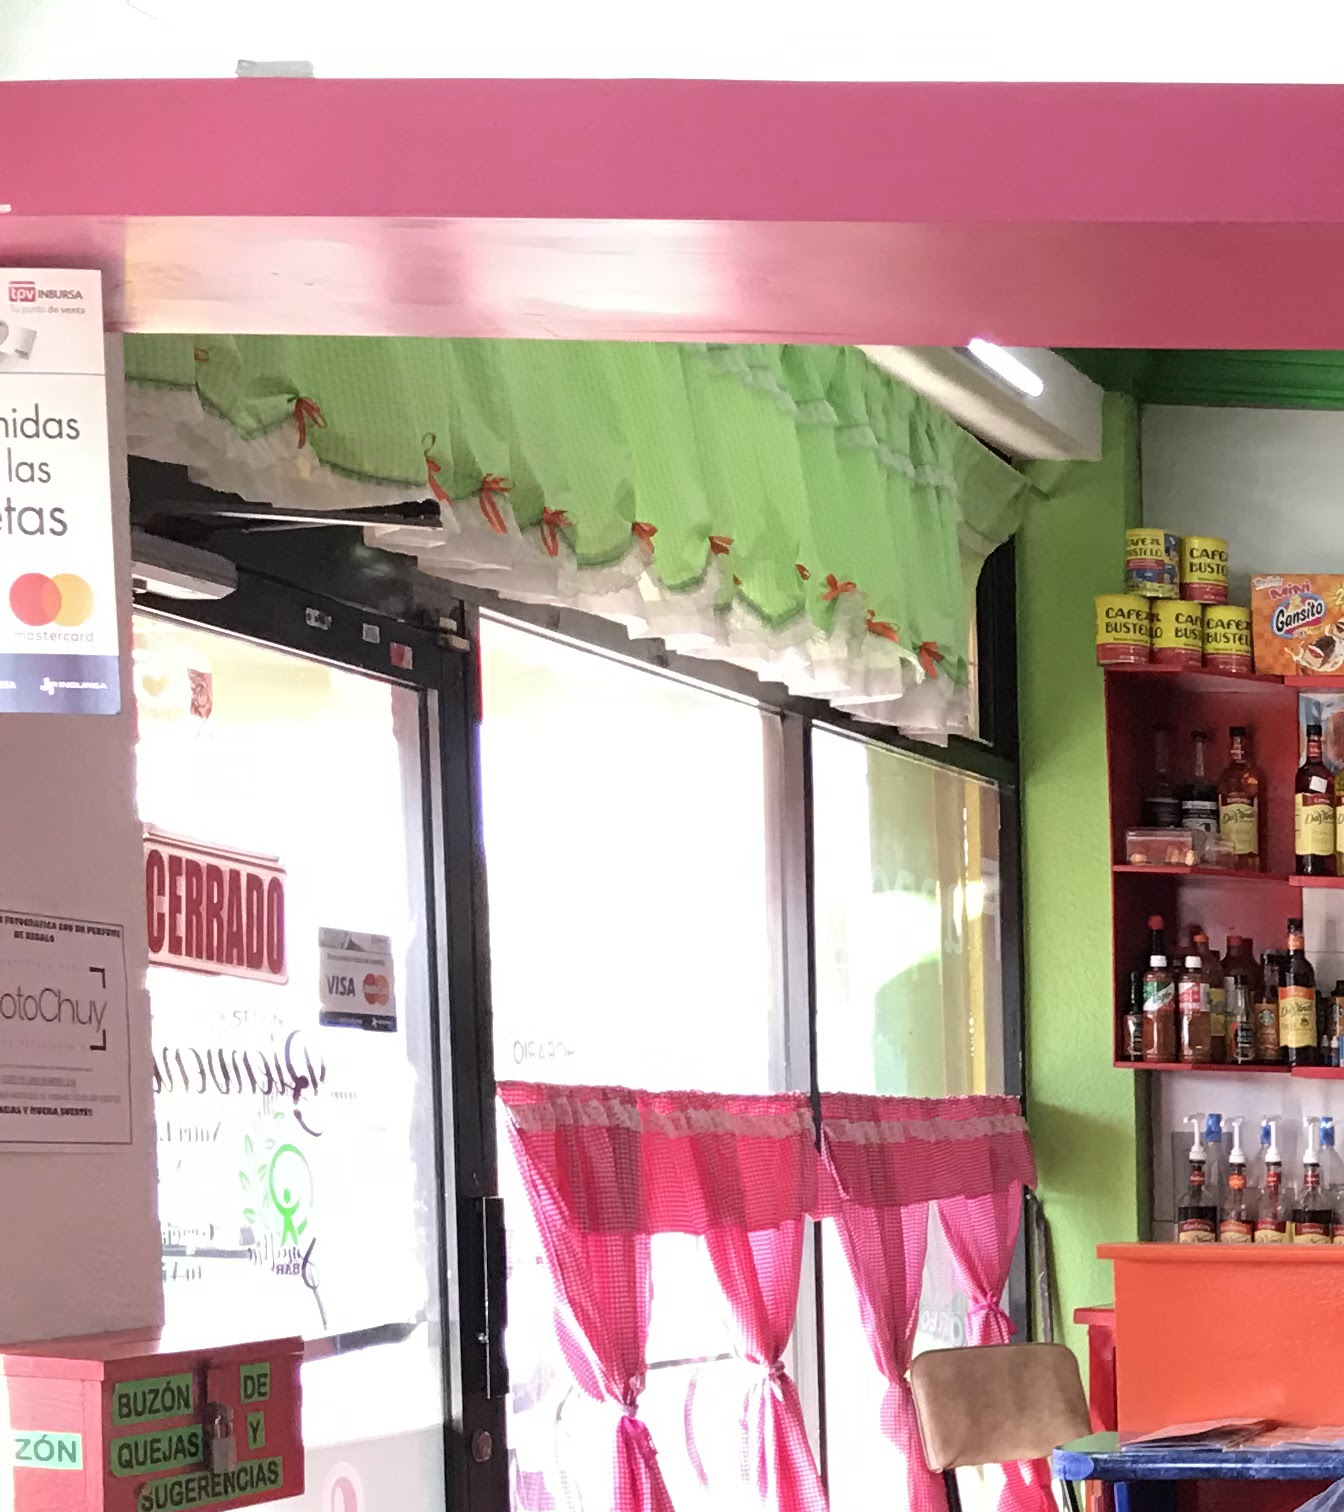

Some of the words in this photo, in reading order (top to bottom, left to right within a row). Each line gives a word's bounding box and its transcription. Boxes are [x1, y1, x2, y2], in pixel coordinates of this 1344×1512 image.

[10, 288, 35, 301] tpv
[37, 289, 83, 299] INBURSA
[60, 307, 86, 315] venta
[7, 446, 52, 484] las
[1276, 601, 1324, 633] Gansito
[15, 631, 94, 643] mastercard
[146, 848, 284, 975] CERRADO
[326, 974, 356, 997] VISA
[117, 1381, 191, 1419] BUZÓN
[243, 1373, 269, 1399] DE
[15, 1434, 78, 1463] ZÓN
[117, 1432, 200, 1470] QUEJAS
[249, 1418, 262, 1444] Y
[140, 1460, 280, 1512] SUGERENCIAS
